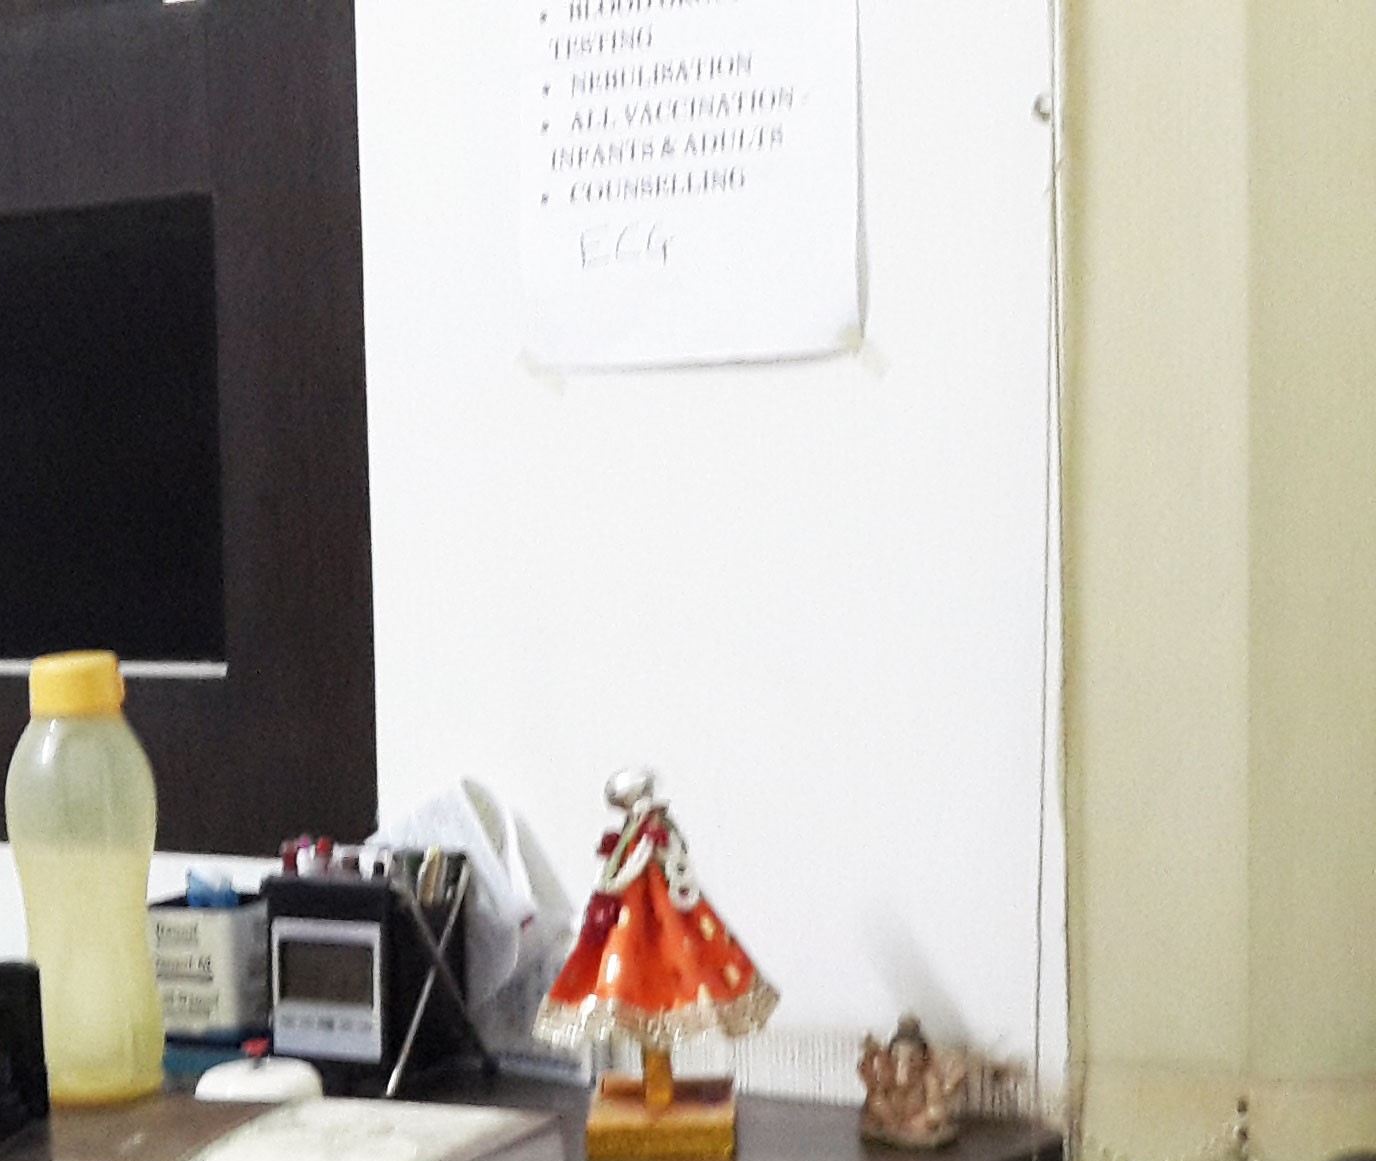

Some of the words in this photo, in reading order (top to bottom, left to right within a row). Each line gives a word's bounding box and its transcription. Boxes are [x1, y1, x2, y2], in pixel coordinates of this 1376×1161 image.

[549, 23, 653, 60] TESTING
[571, 50, 753, 97] NEBULISATION
[571, 106, 615, 131] ALL
[624, 86, 794, 126] VACCINATION
[551, 137, 654, 171] INFANTS
[660, 135, 676, 157] &
[684, 123, 784, 156] ADULTS
[569, 166, 746, 204] COUNSELLING
